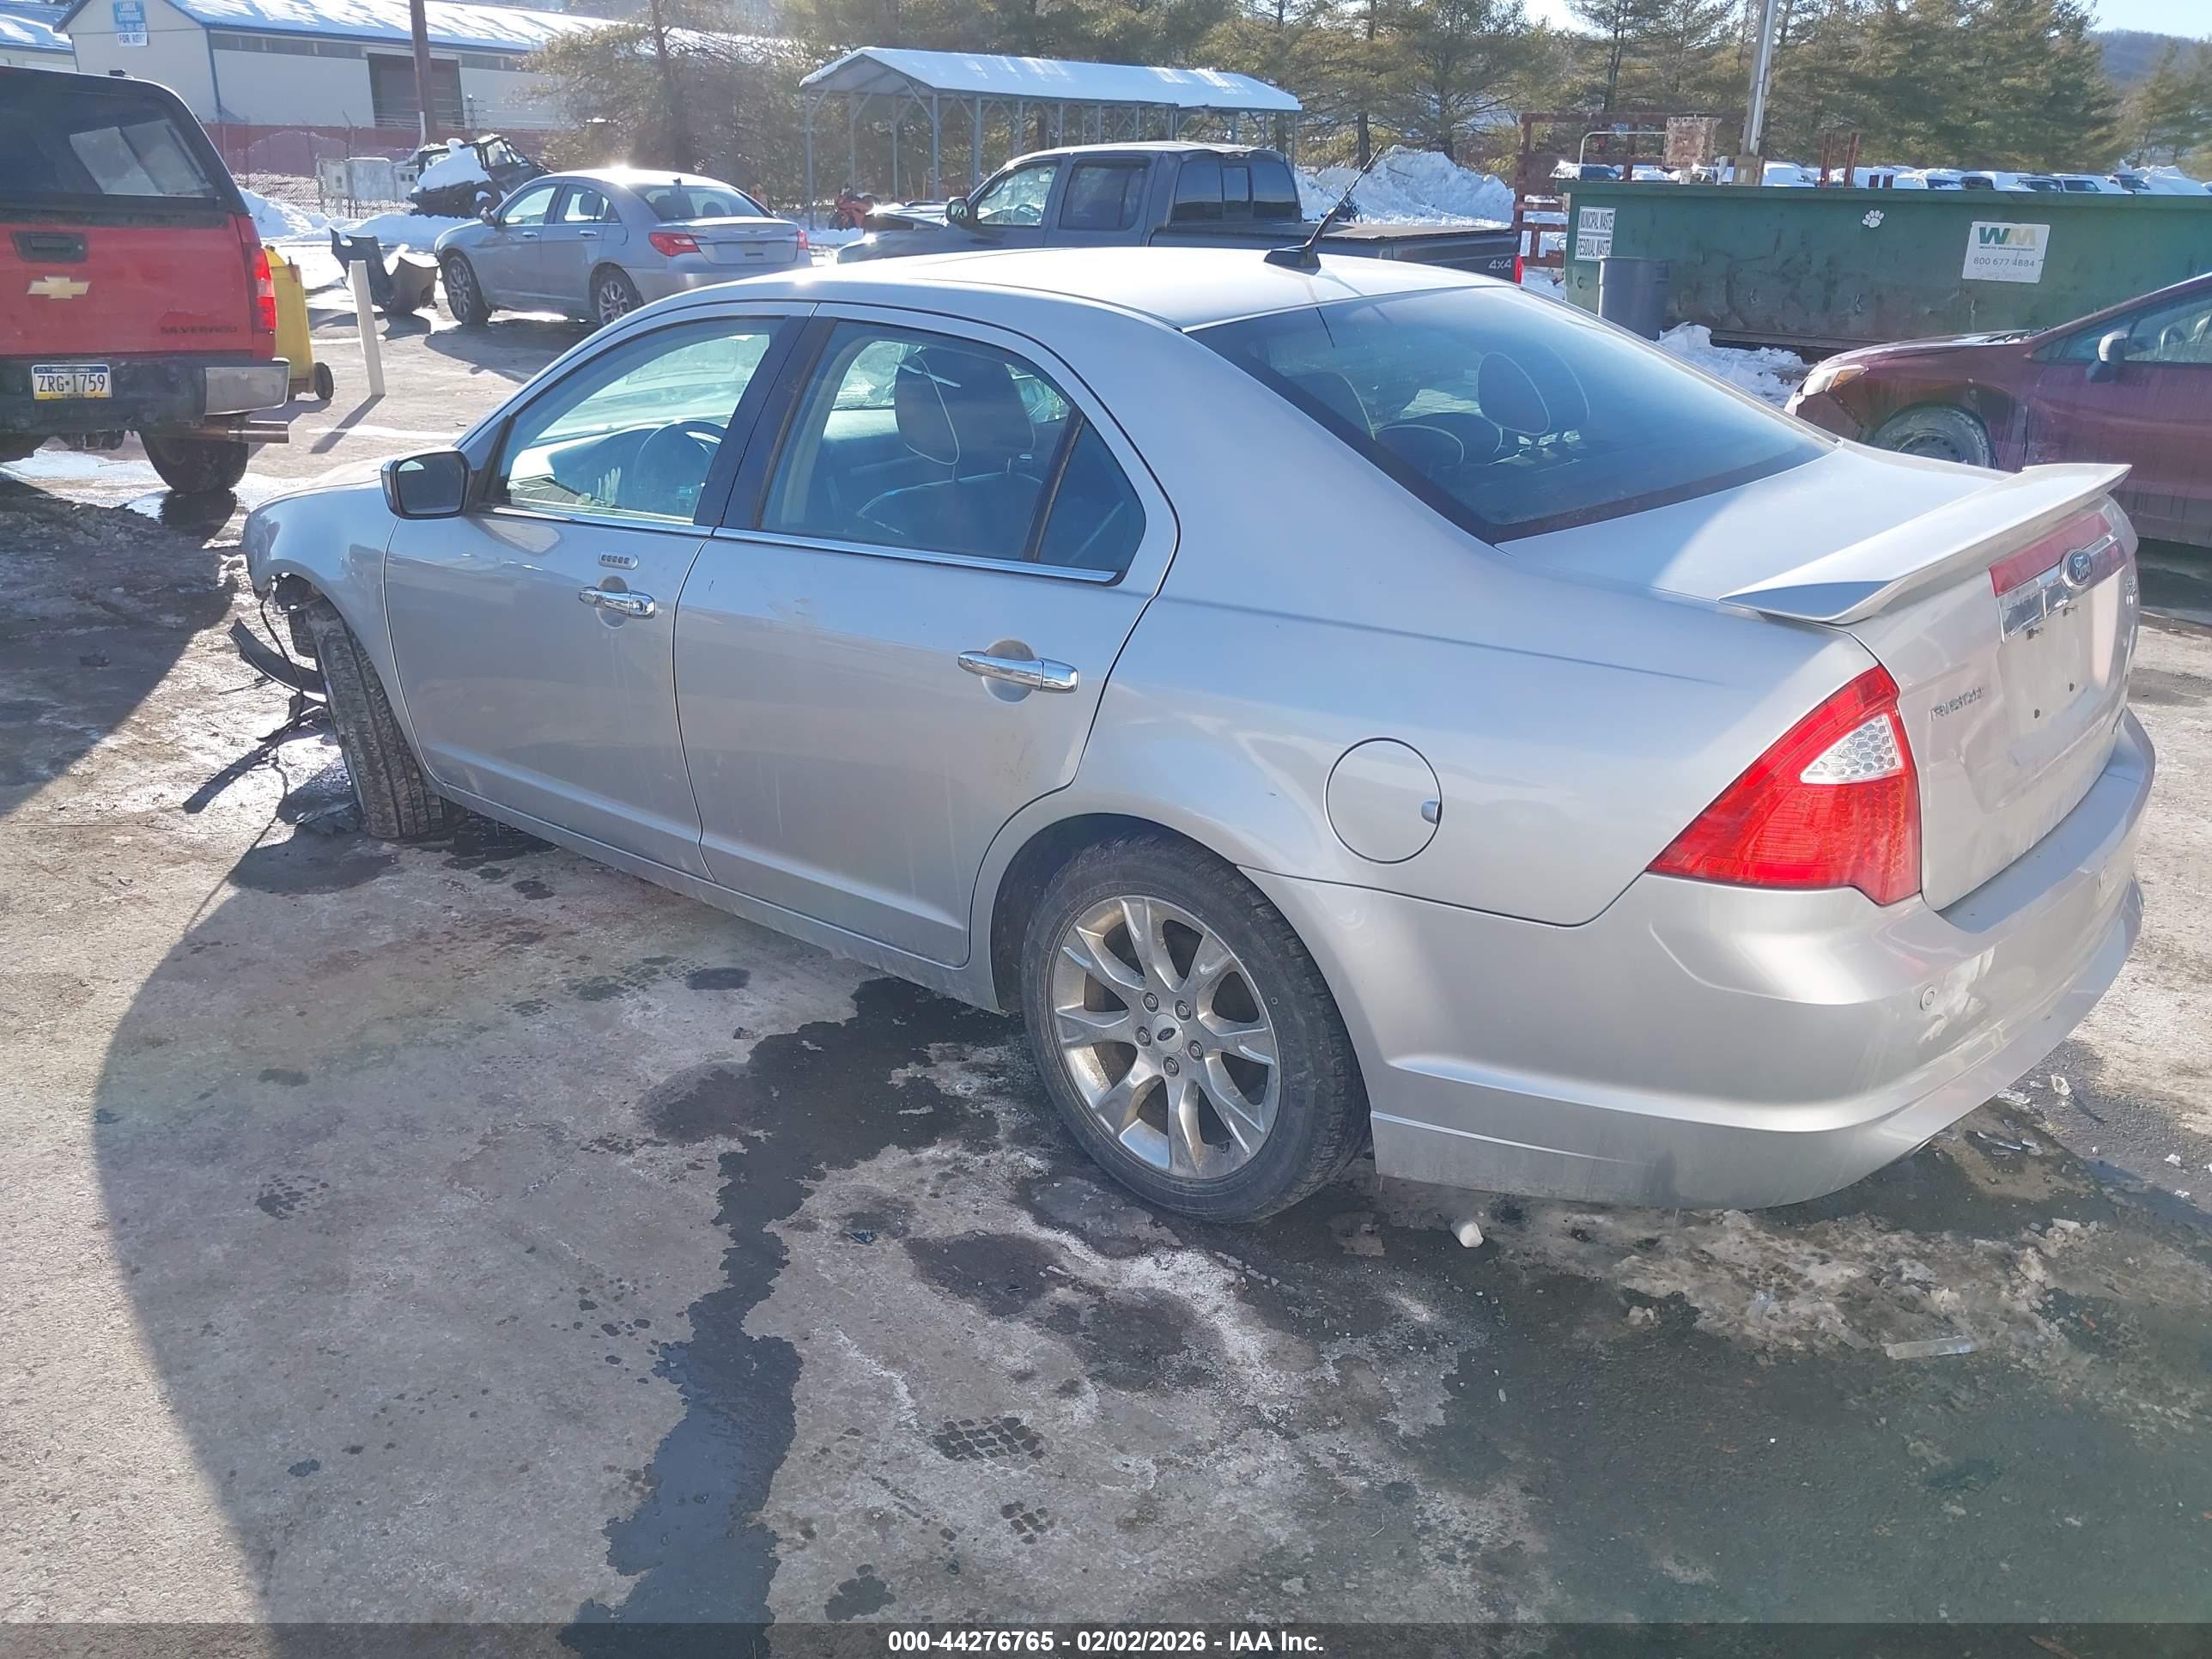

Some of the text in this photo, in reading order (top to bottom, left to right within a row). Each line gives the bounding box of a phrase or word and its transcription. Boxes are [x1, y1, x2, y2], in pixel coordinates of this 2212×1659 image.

[118, 33, 131, 44] FOR
[1599, 212, 1614, 230] WASTE
[1978, 227, 2035, 246] WM
[1973, 257, 1990, 265] 800
[1992, 258, 2009, 266] 677
